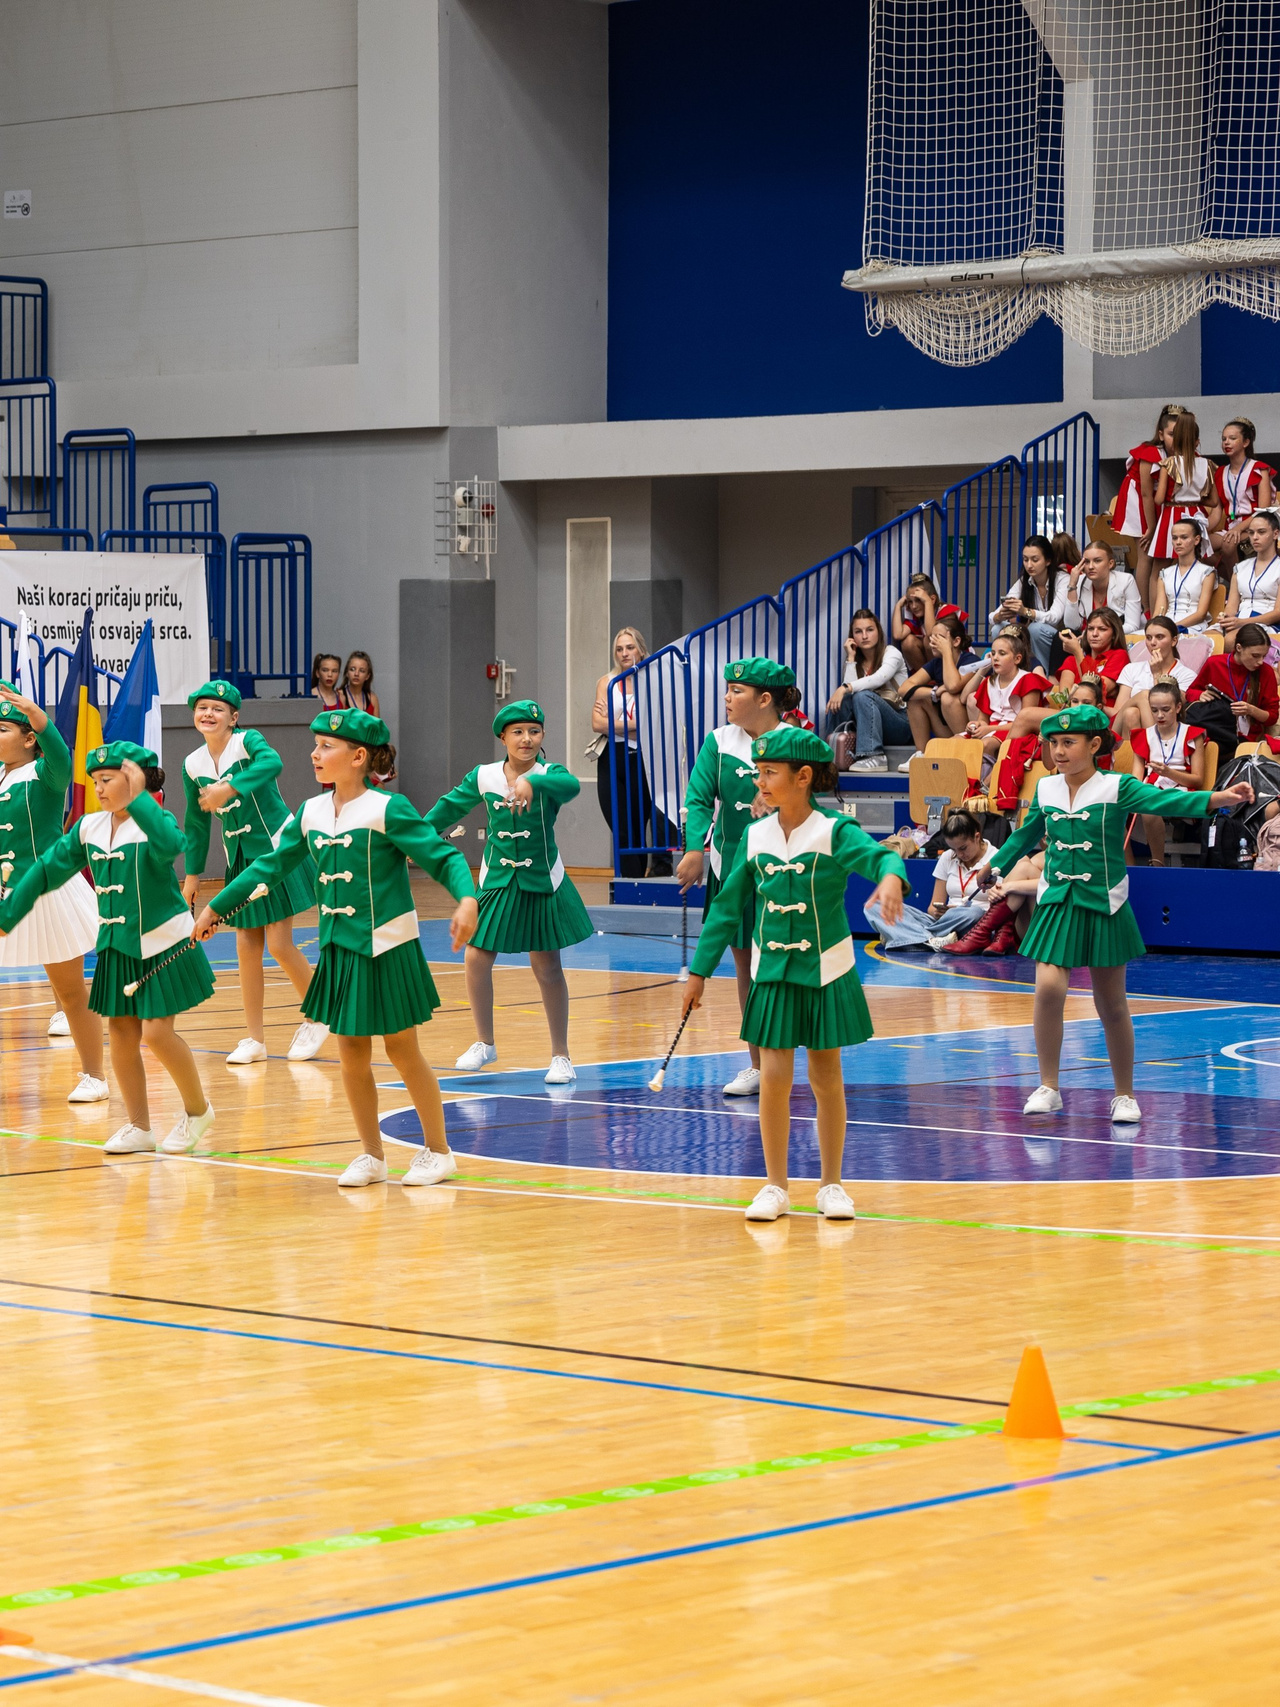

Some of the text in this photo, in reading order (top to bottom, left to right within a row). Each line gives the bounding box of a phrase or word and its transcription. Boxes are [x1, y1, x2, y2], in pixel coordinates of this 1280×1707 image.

[950, 272, 994, 282] elan
[17, 584, 183, 612] Naši koraci pričaju priču,
[42, 620, 95, 645] osmijei
[159, 624, 192, 640] srca.
